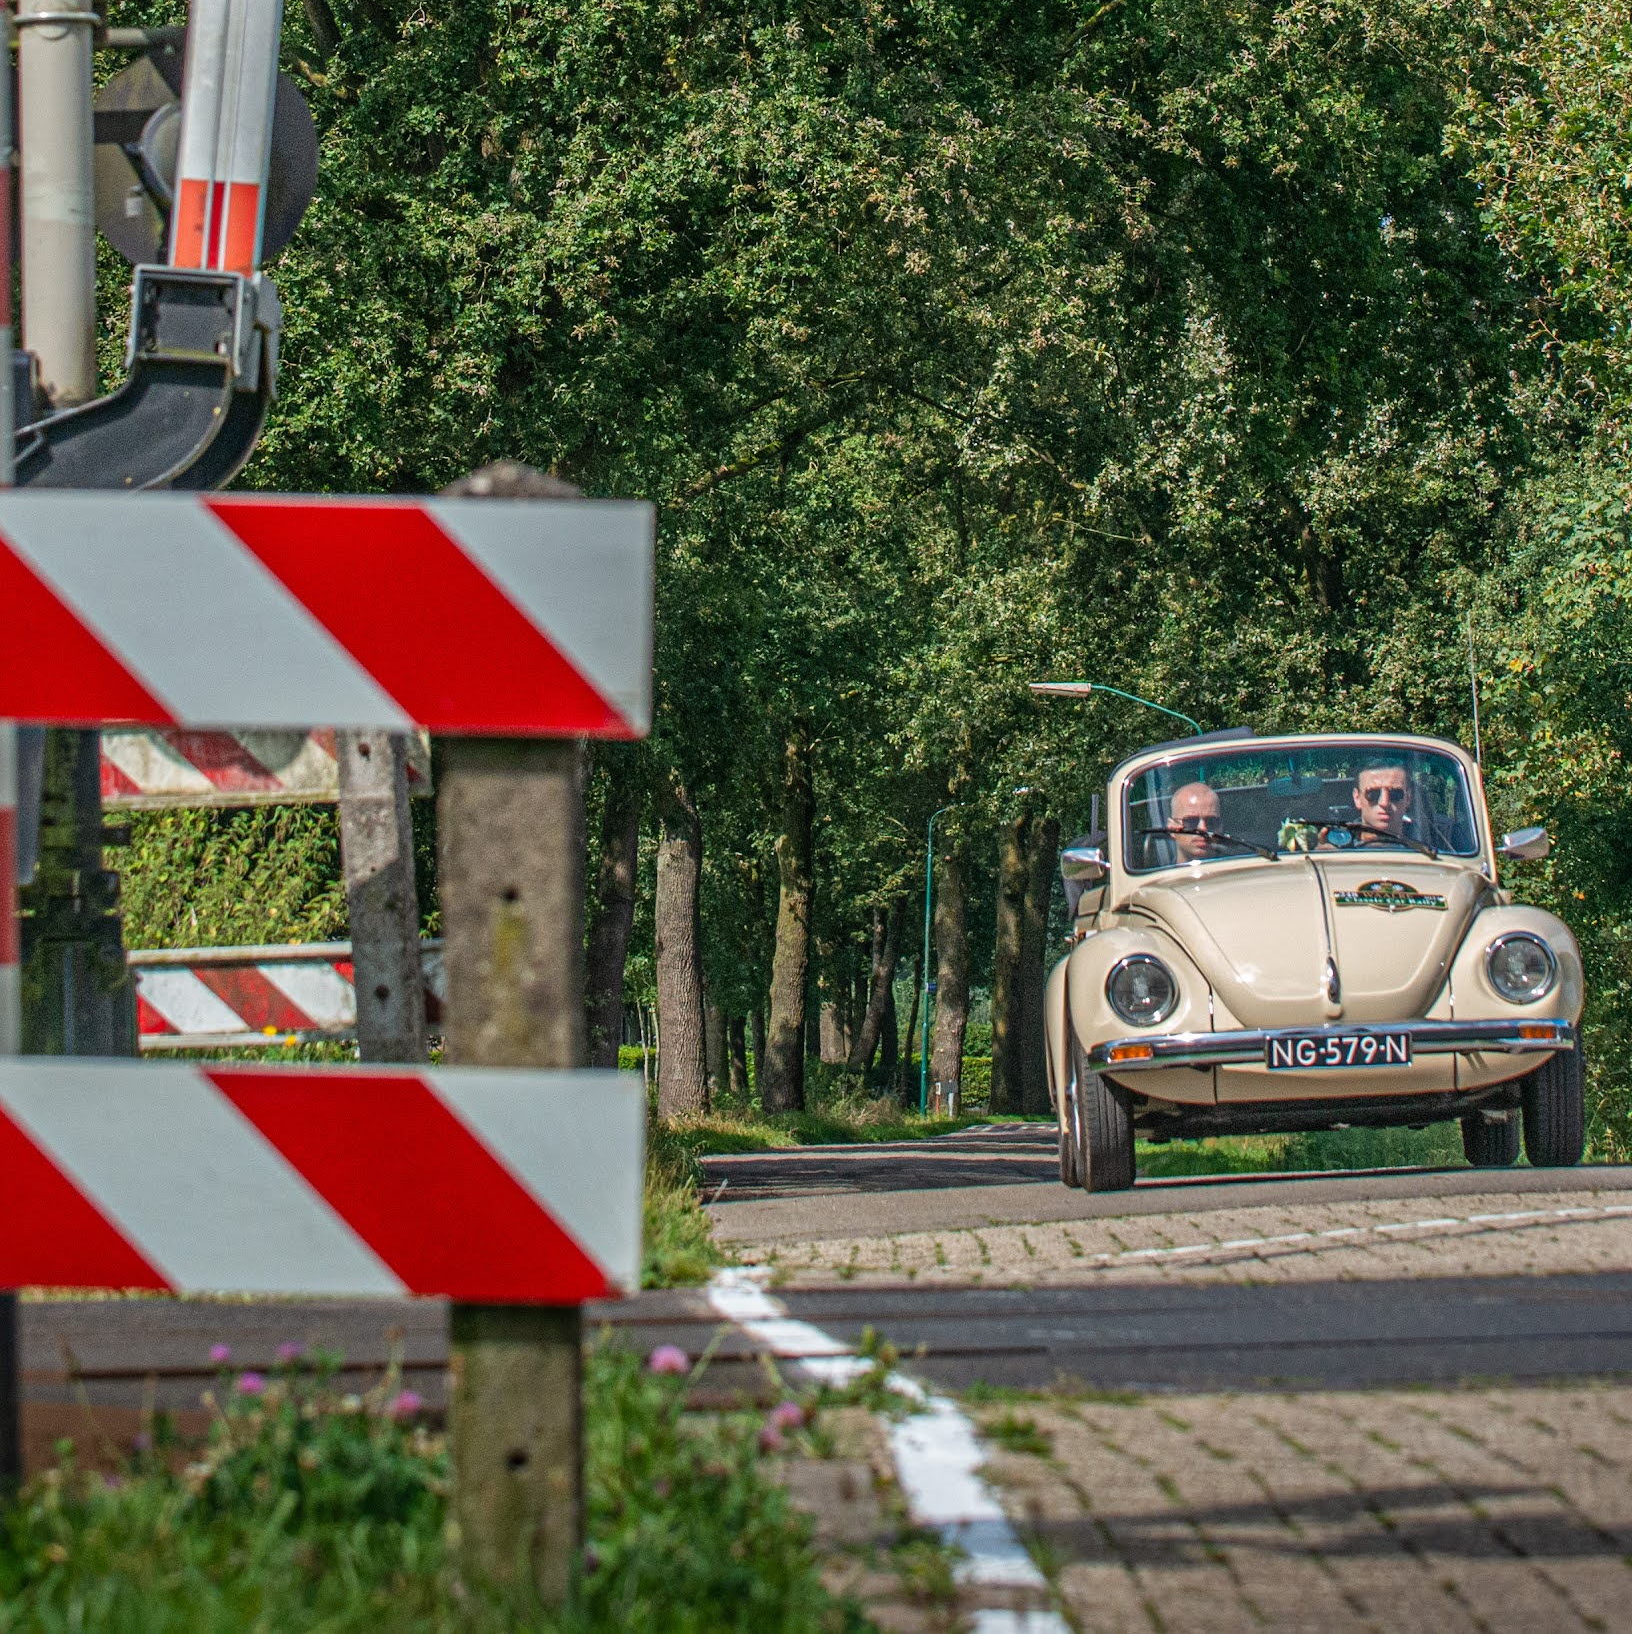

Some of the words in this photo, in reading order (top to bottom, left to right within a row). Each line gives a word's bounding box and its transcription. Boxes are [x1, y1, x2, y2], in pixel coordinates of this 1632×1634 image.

[1386, 897, 1405, 905] Car
[1408, 898, 1437, 907] Rally
[1272, 1035, 1407, 1067] NG-579-N
